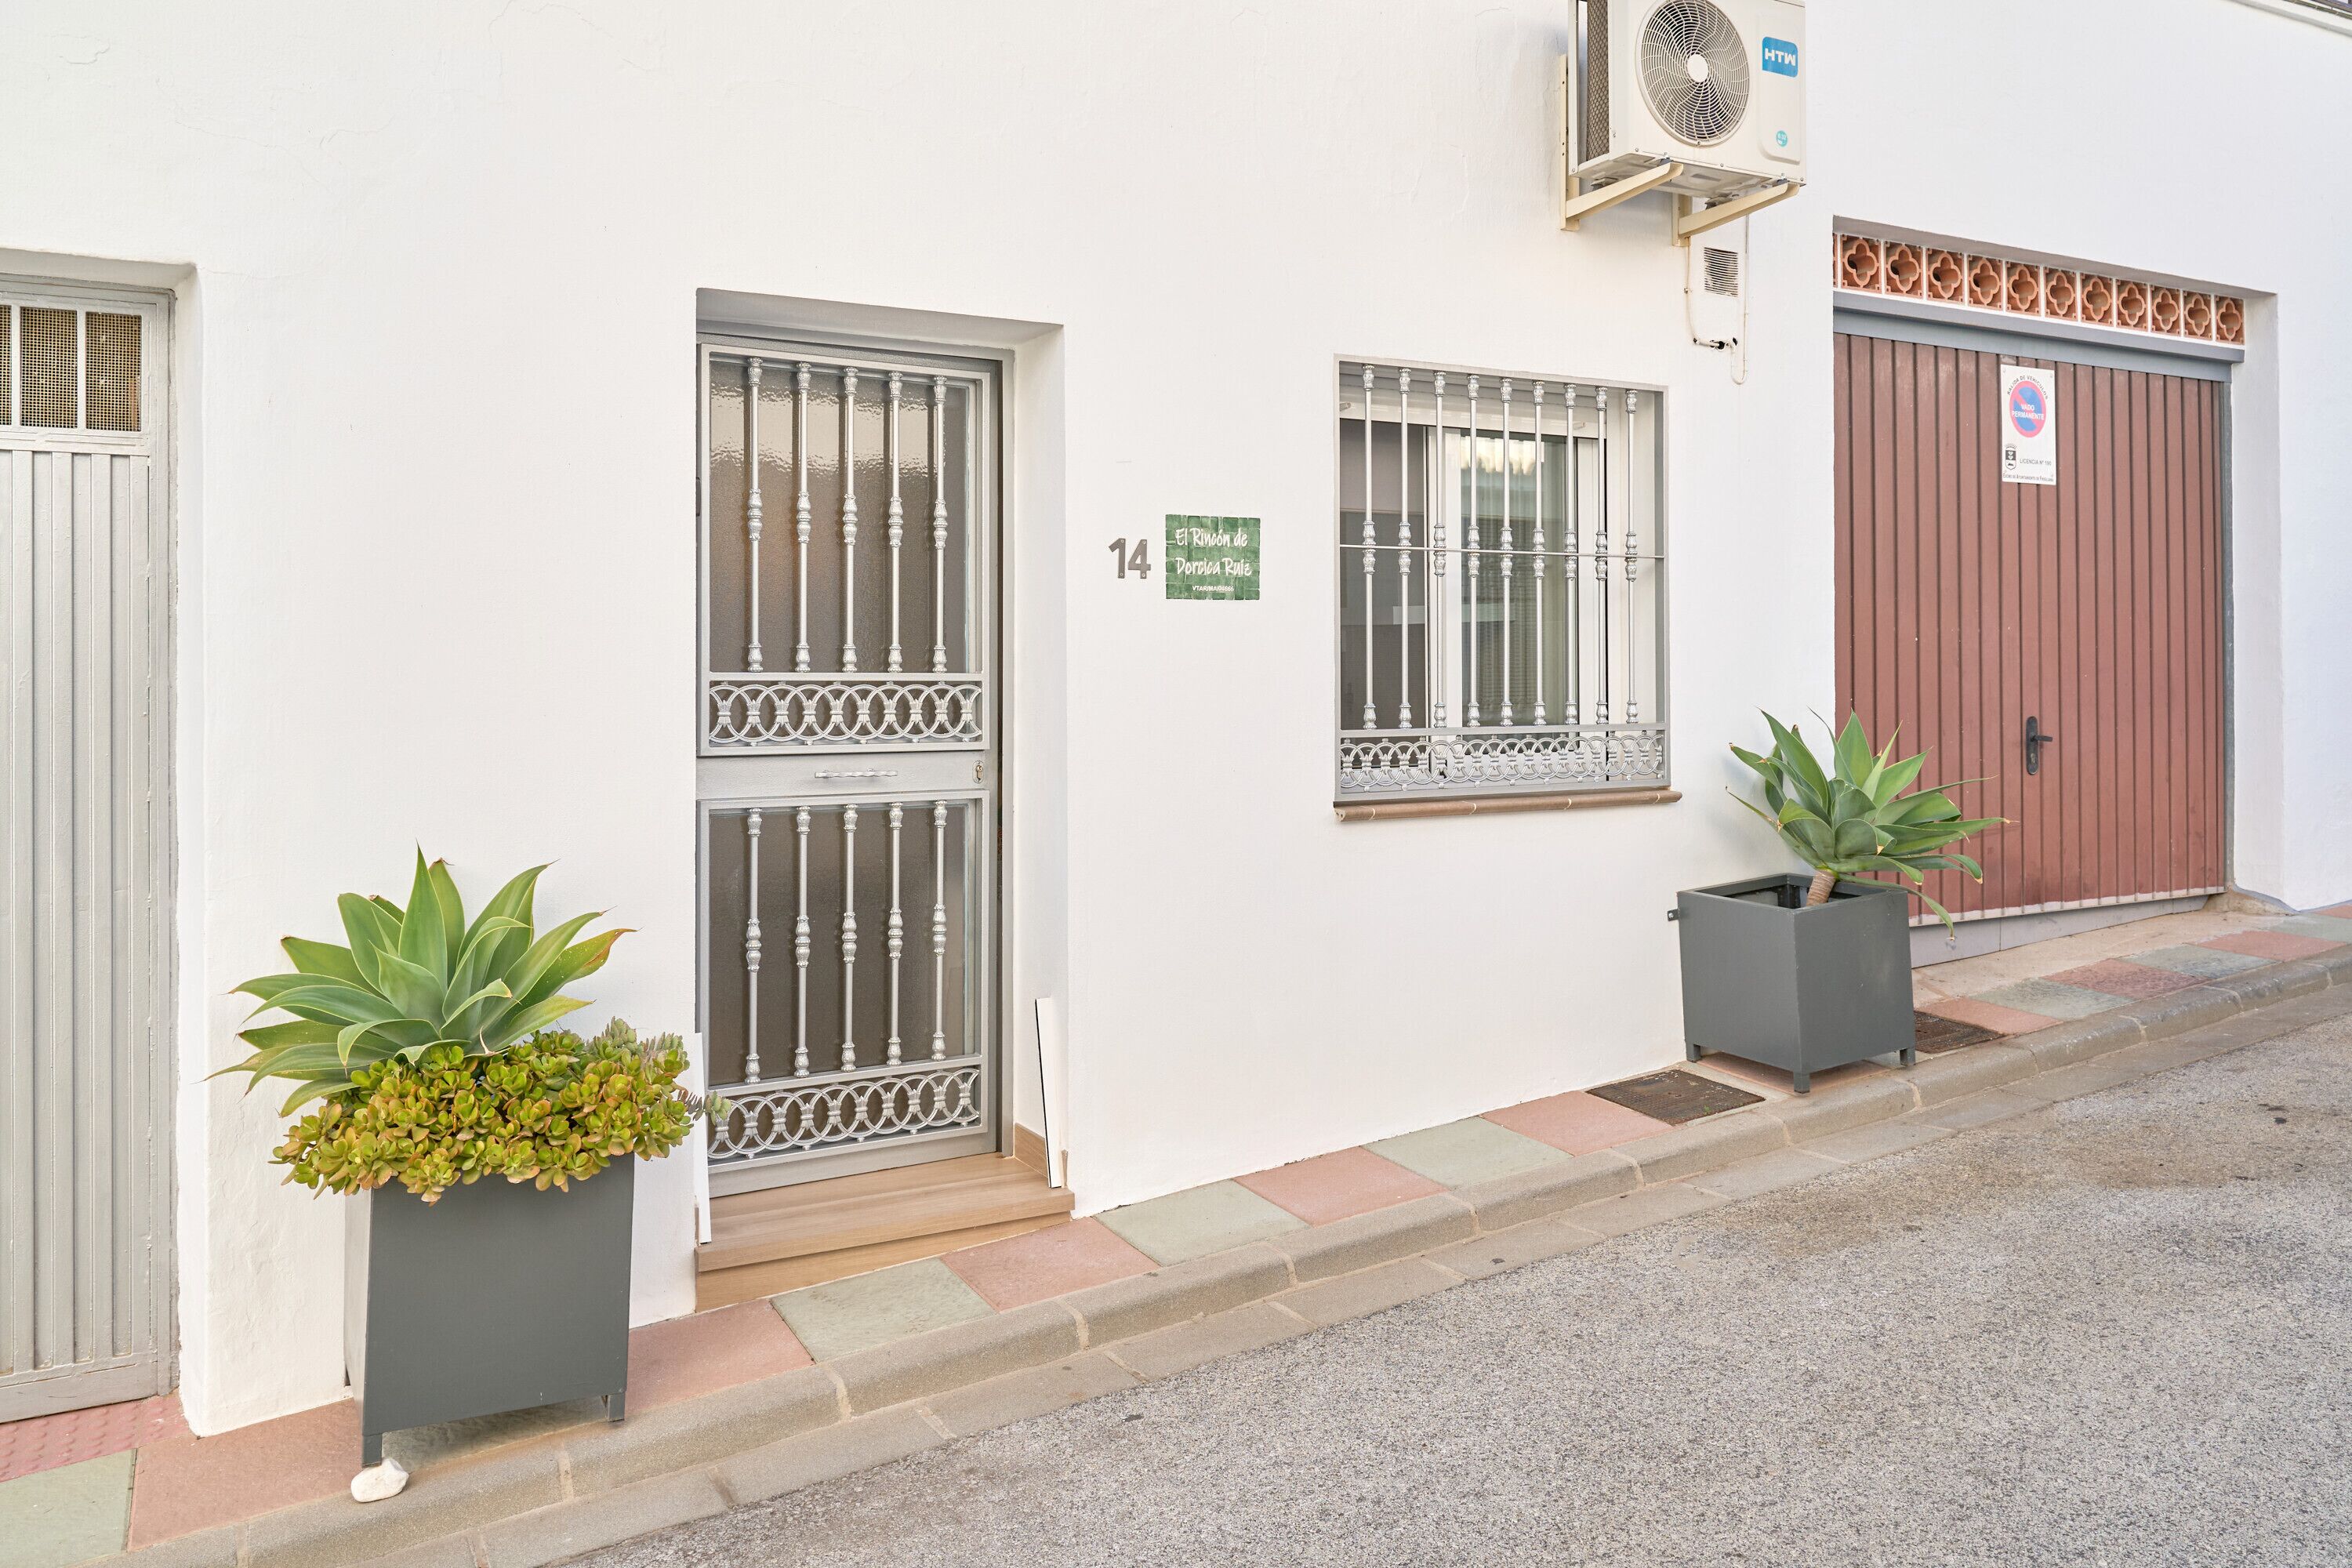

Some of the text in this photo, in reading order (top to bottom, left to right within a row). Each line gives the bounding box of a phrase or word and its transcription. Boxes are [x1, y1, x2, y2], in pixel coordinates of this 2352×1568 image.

[1765, 48, 1796, 67] HTW
[2011, 410, 2045, 420] PERMANENTE
[1175, 528, 1248, 546] El Rincón de
[1109, 538, 1151, 579] 14
[1174, 557, 1220, 575] Dorcica
